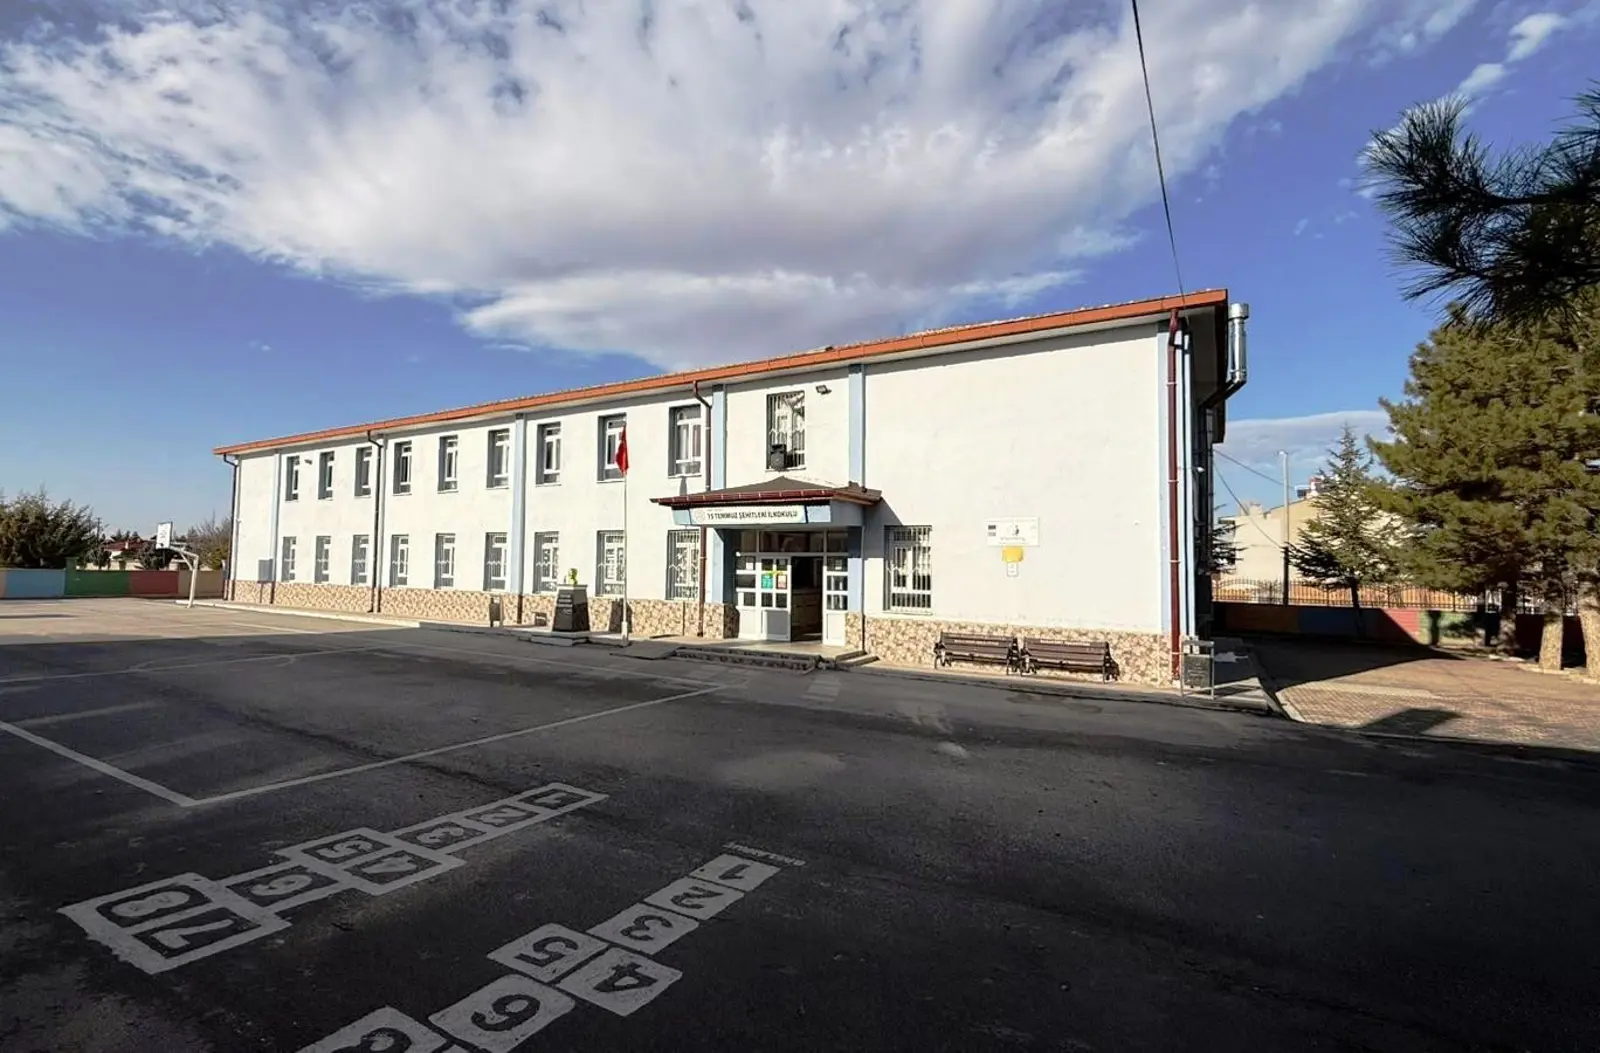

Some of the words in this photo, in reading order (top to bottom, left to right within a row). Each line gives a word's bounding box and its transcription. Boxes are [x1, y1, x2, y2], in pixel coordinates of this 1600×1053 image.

[481, 807, 528, 826] 2
[417, 823, 464, 844] 3
[110, 890, 191, 917] 8
[671, 886, 724, 909] 2
[150, 919, 234, 949] 7
[620, 915, 673, 941] 3
[514, 936, 579, 967] 5
[592, 963, 659, 993] 4
